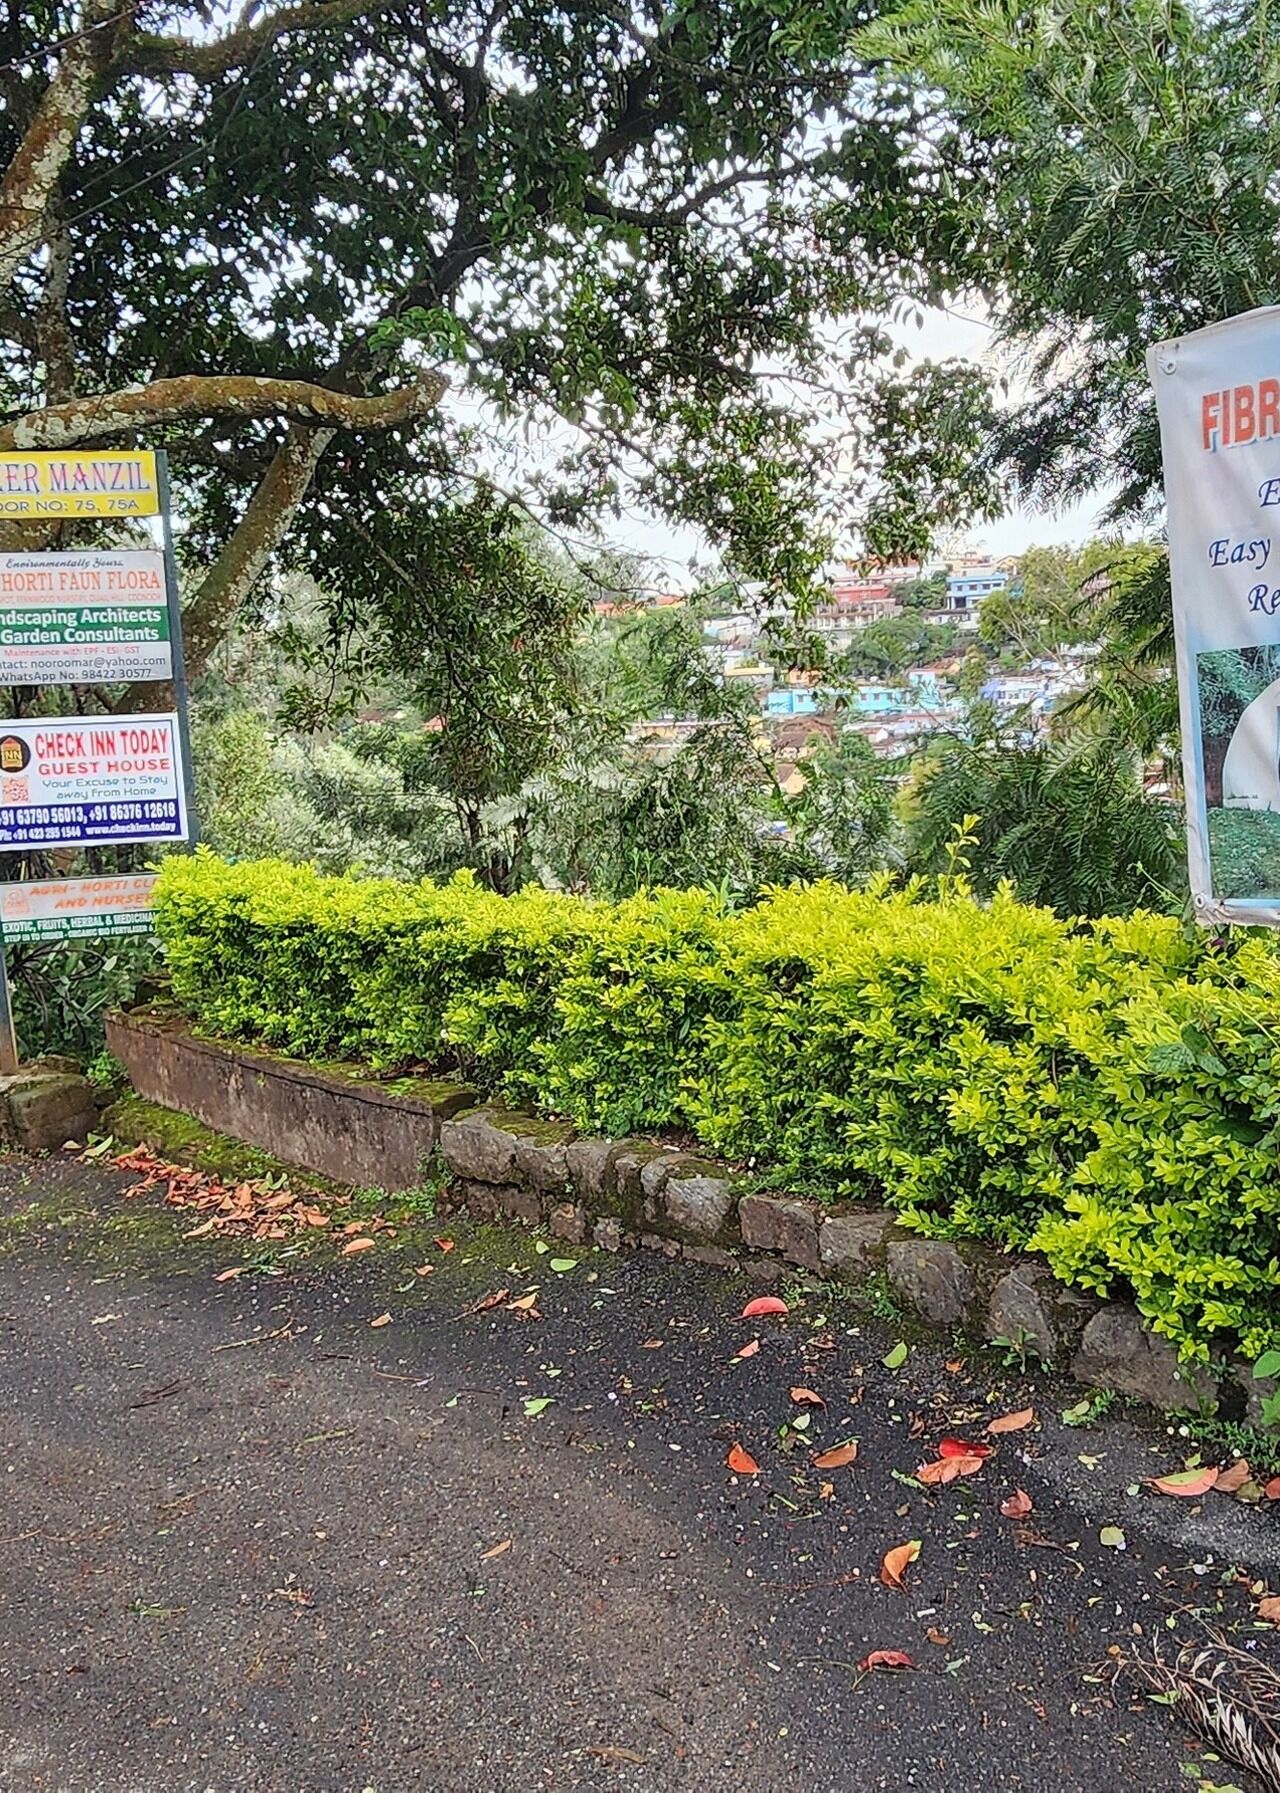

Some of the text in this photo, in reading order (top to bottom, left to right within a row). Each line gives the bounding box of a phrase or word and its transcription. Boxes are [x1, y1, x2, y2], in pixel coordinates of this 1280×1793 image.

[48, 462, 151, 493] MANZIL
[36, 500, 69, 512] NO:
[75, 500, 101, 513] 75,
[108, 499, 140, 511] 75A
[1208, 537, 1271, 570] Easy
[5, 558, 91, 569] Environmentally
[1, 569, 161, 592] HORTI FAUN FLORA
[80, 608, 162, 624] Architects
[0, 629, 61, 643] Garden
[64, 625, 160, 642] Consultants
[4, 649, 60, 657] Maintenance
[30, 656, 167, 669] nooroomar@yahoo.com
[59, 670, 80, 681] No:
[81, 669, 116, 680] 98422
[119, 667, 152, 679] 30577
[35, 728, 168, 759] CHECK INN TODAY
[38, 758, 170, 776] GUEST HOUSE
[42, 776, 168, 788] Your Excuse to Stay
[56, 791, 89, 800] away
[124, 787, 157, 796] Home
[16, 808, 49, 825] 63790
[51, 806, 87, 824] 56013,
[89, 805, 107, 821] +91
[109, 803, 142, 820] 86376
[144, 801, 176, 818] 12618
[13, 828, 27, 839] +91
[81, 880, 128, 892] HORTI
[54, 898, 87, 909] AND
[2, 921, 36, 933] EXOTIC,
[37, 918, 70, 930] FRUITS,
[71, 916, 104, 928] HERBAL
[105, 915, 112, 925] &
